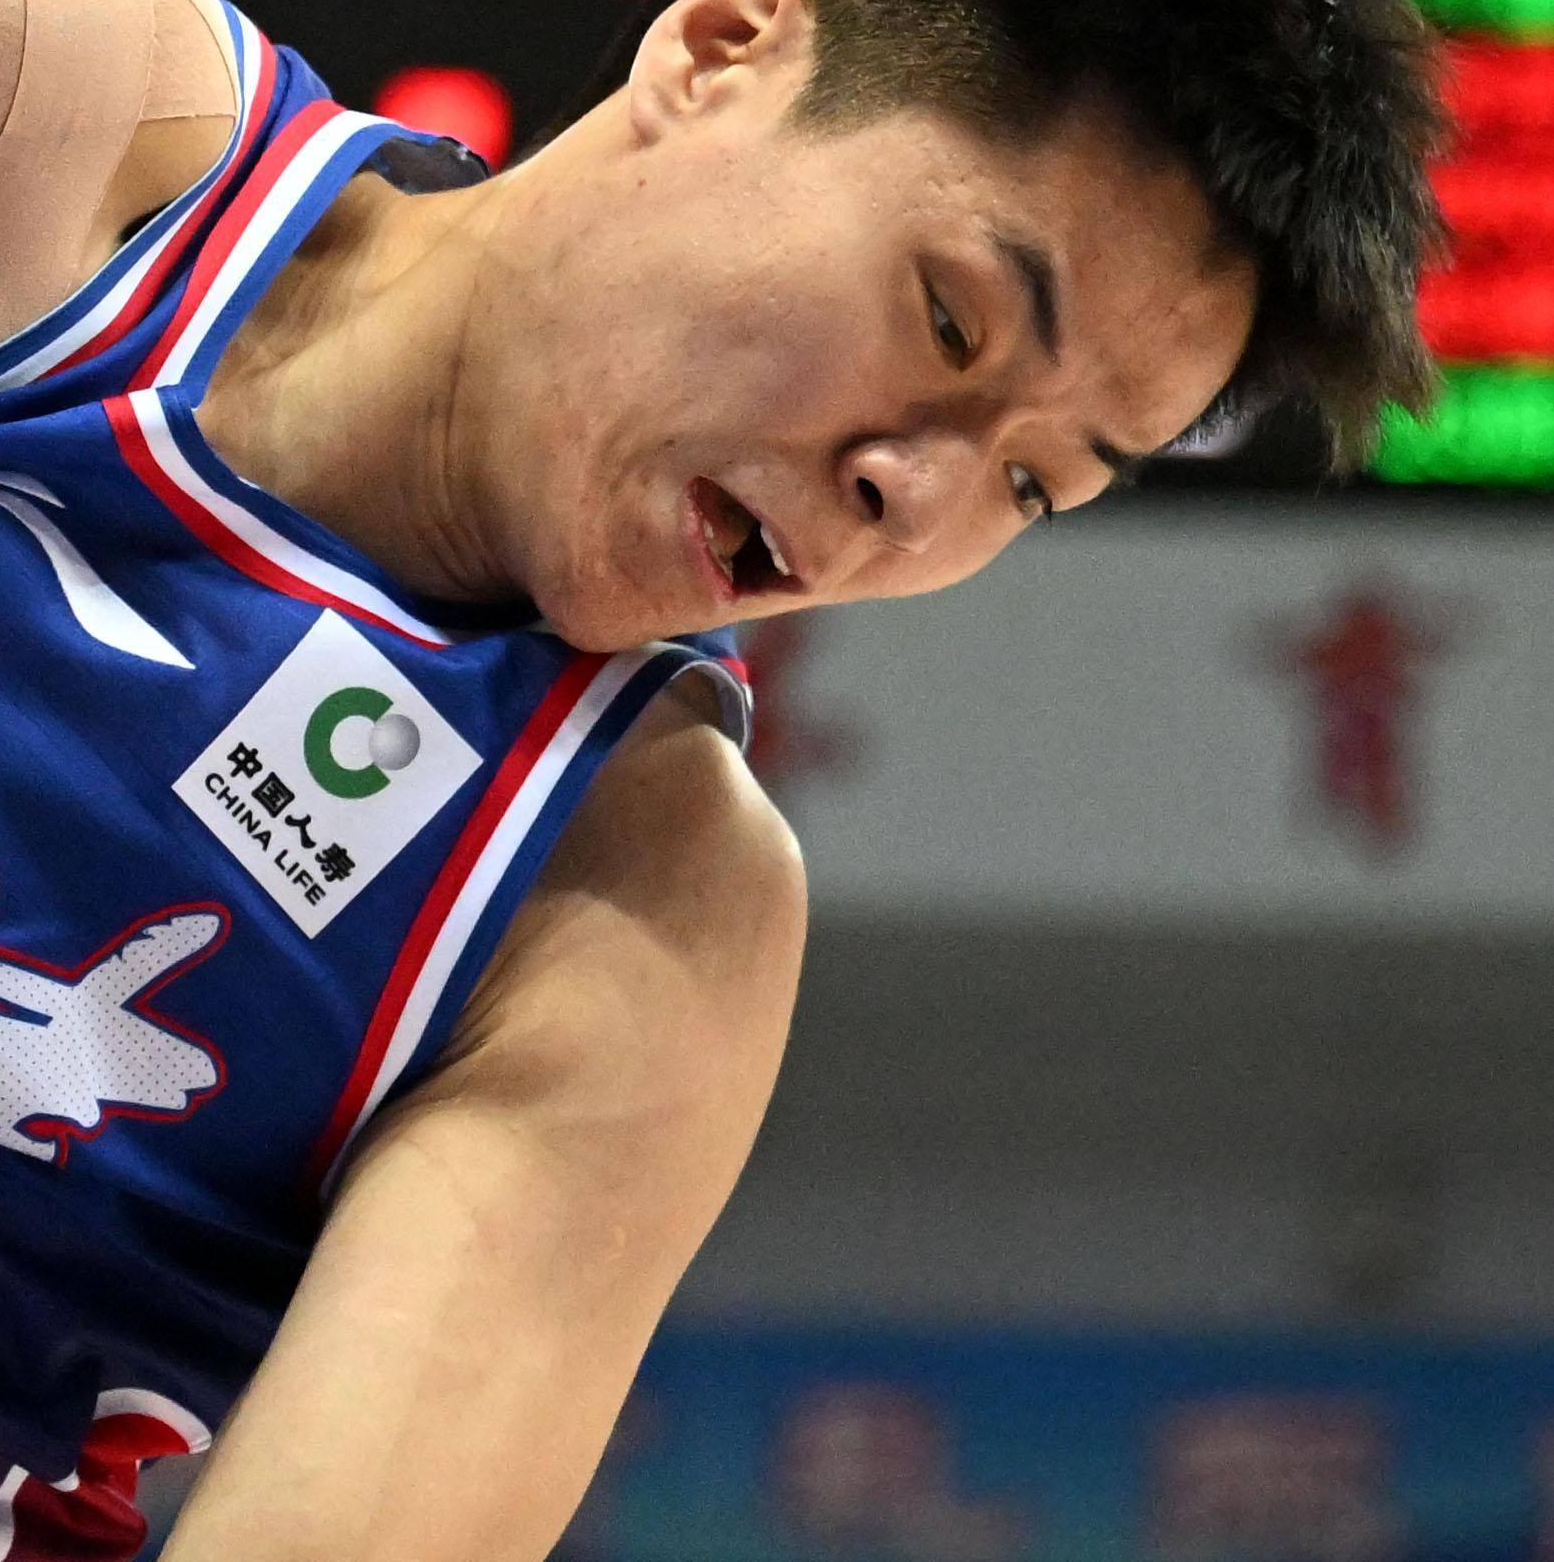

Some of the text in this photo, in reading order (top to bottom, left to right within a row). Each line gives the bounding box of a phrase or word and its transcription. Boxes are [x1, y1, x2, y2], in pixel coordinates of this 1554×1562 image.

[204, 772, 327, 907] CHINA LIFE
[227, 741, 357, 883] 中国人寿
